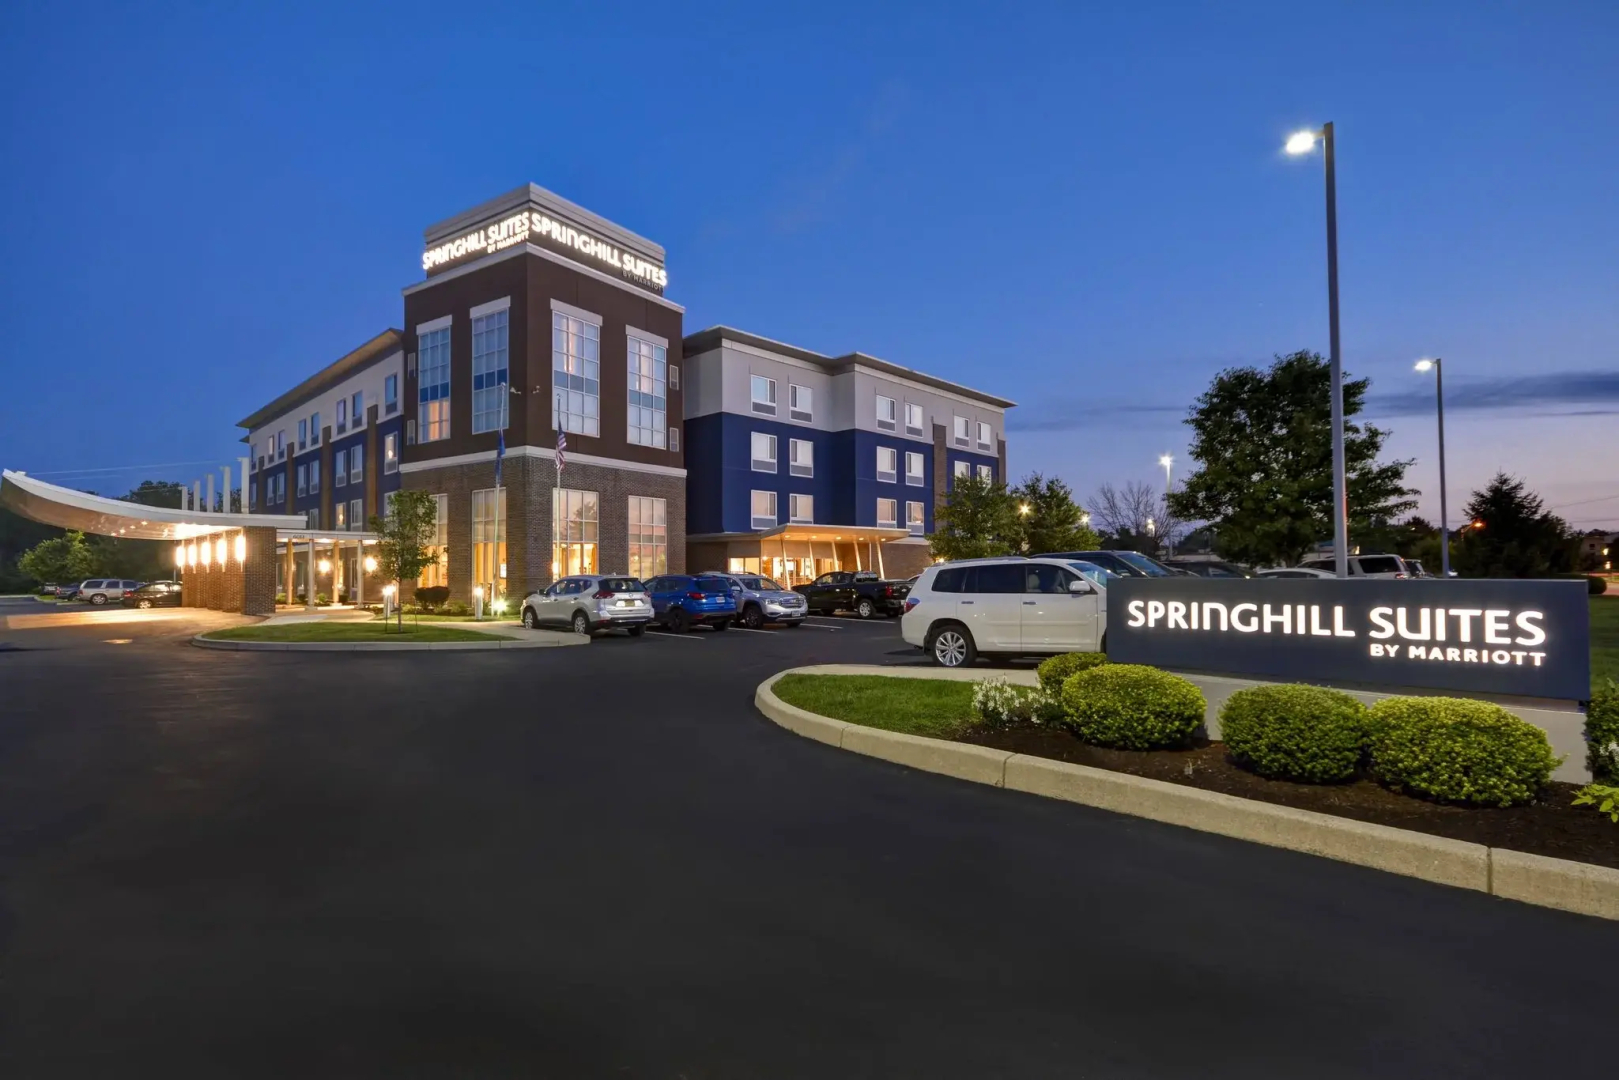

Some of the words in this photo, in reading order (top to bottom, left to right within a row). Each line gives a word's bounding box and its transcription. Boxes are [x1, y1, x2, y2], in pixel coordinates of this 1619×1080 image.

[422, 229, 488, 270] SPRINGHILL
[487, 211, 530, 244] SUITES
[531, 212, 622, 268] SPRINGHILL
[622, 253, 668, 286] SUITES
[622, 270, 632, 279] BY
[1127, 600, 1356, 637] SPRINGHILL
[1369, 606, 1546, 646] SUITES
[1369, 643, 1400, 658] BY
[1408, 645, 1547, 667] MARRIOTT
